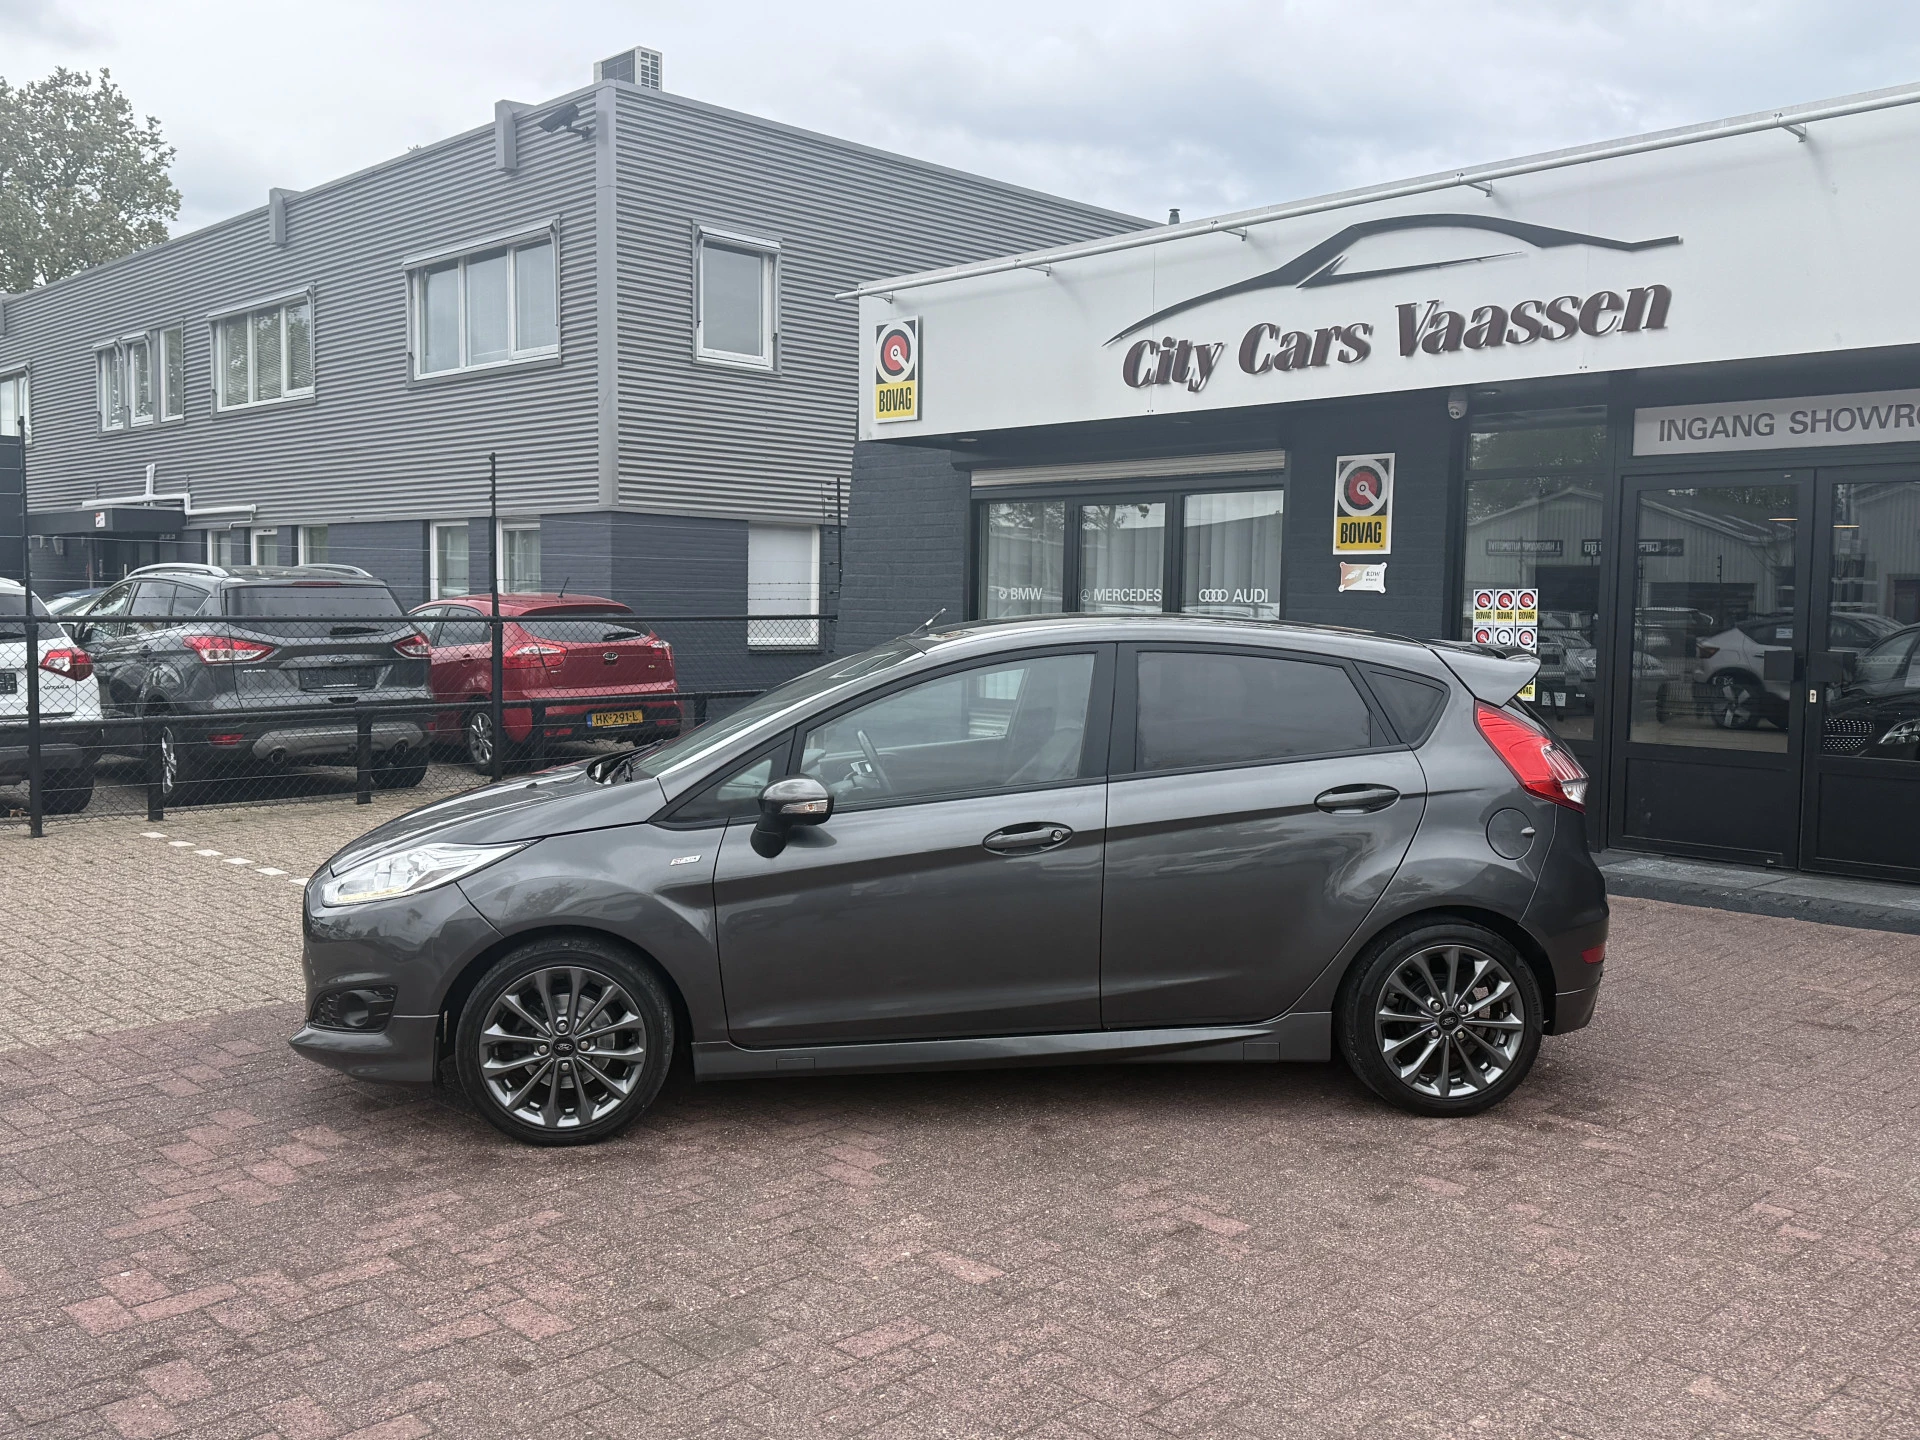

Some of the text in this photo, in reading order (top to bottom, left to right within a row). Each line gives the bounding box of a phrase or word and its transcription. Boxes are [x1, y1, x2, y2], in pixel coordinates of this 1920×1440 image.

[1122, 281, 1672, 393] City Cars Vaassen
[879, 387, 912, 412] BOVAG
[1658, 402, 1920, 442] INGANG SHOWR
[1340, 521, 1382, 544] BOVAG
[1010, 588, 1043, 601] BMW
[1093, 588, 1162, 602] MERCEDES
[1232, 588, 1269, 603] AUDI
[1476, 611, 1491, 620] BOVAG
[1497, 611, 1513, 620] BOVAG
[1519, 611, 1534, 620] BOVAG
